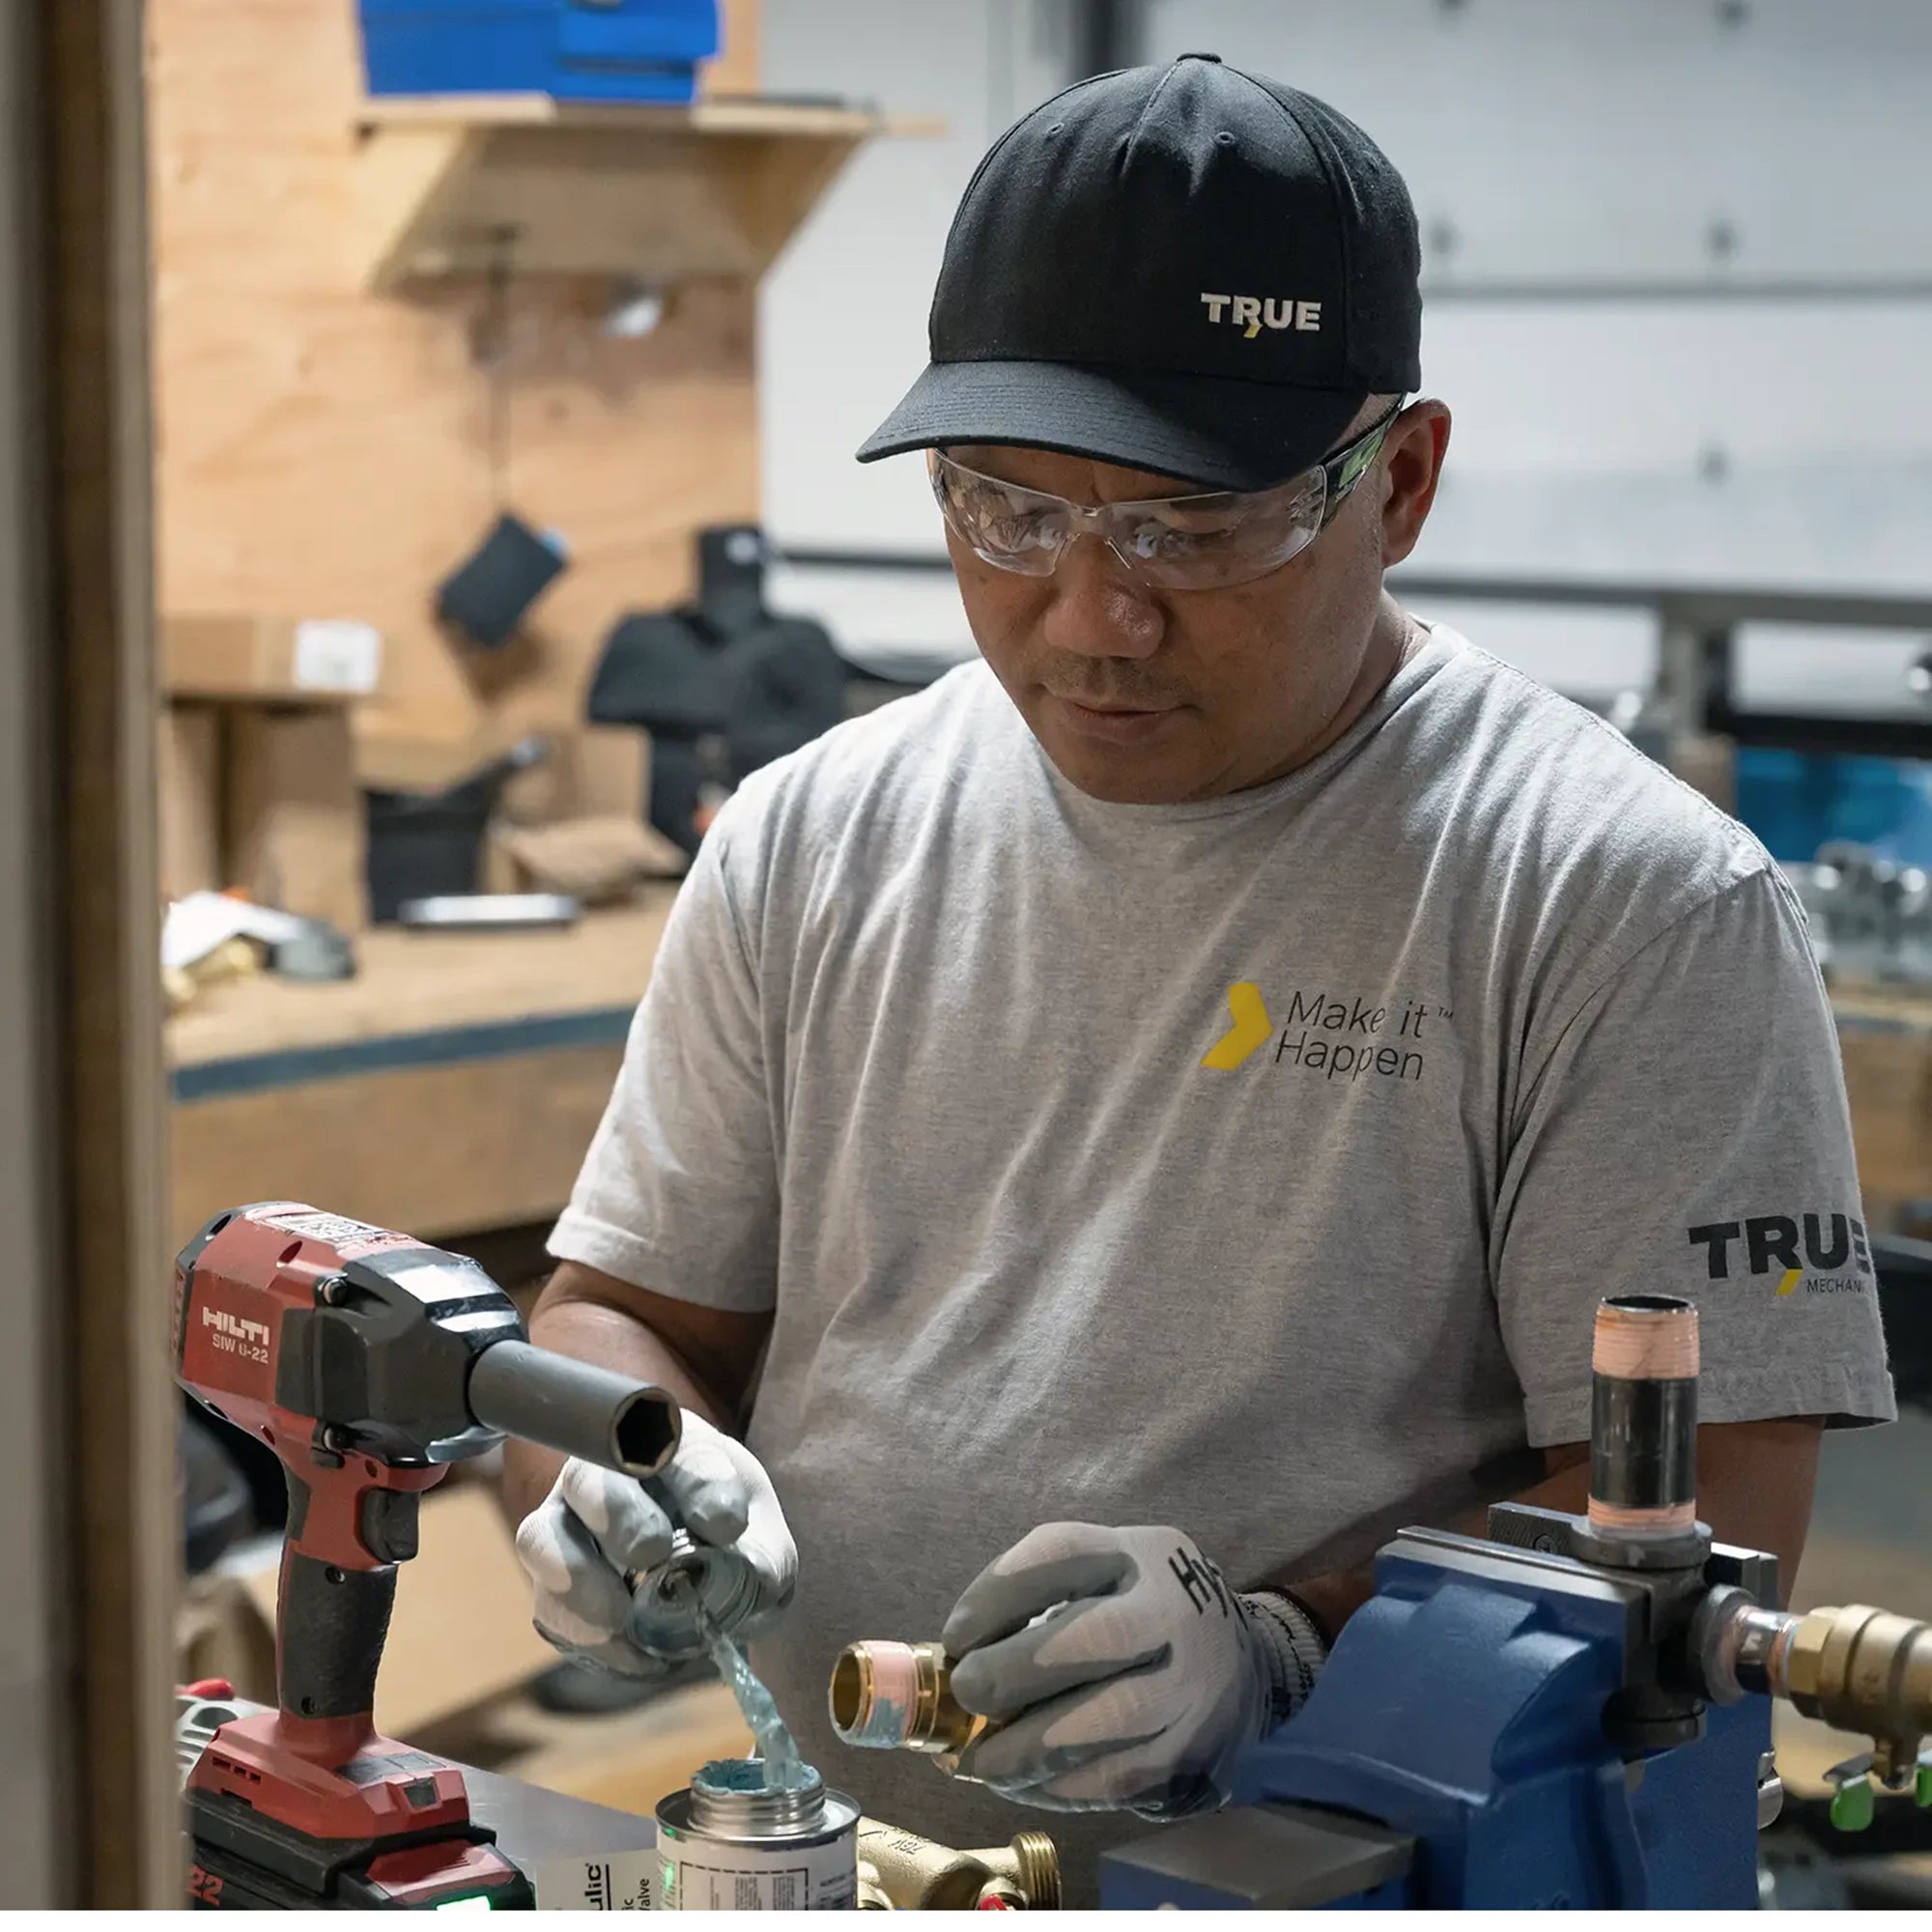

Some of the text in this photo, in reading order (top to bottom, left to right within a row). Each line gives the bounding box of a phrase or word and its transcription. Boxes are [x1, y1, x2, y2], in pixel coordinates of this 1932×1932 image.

[1201, 293, 1321, 338] TRUE
[1288, 991, 1385, 1034] Make
[1401, 1001, 1427, 1037] it
[1275, 1031, 1424, 1081] Happen
[1688, 1213, 1871, 1295] TRUE
[1806, 1278, 1864, 1293] MECHAN
[203, 1306, 270, 1346] HILTI
[213, 1333, 236, 1352] SIW
